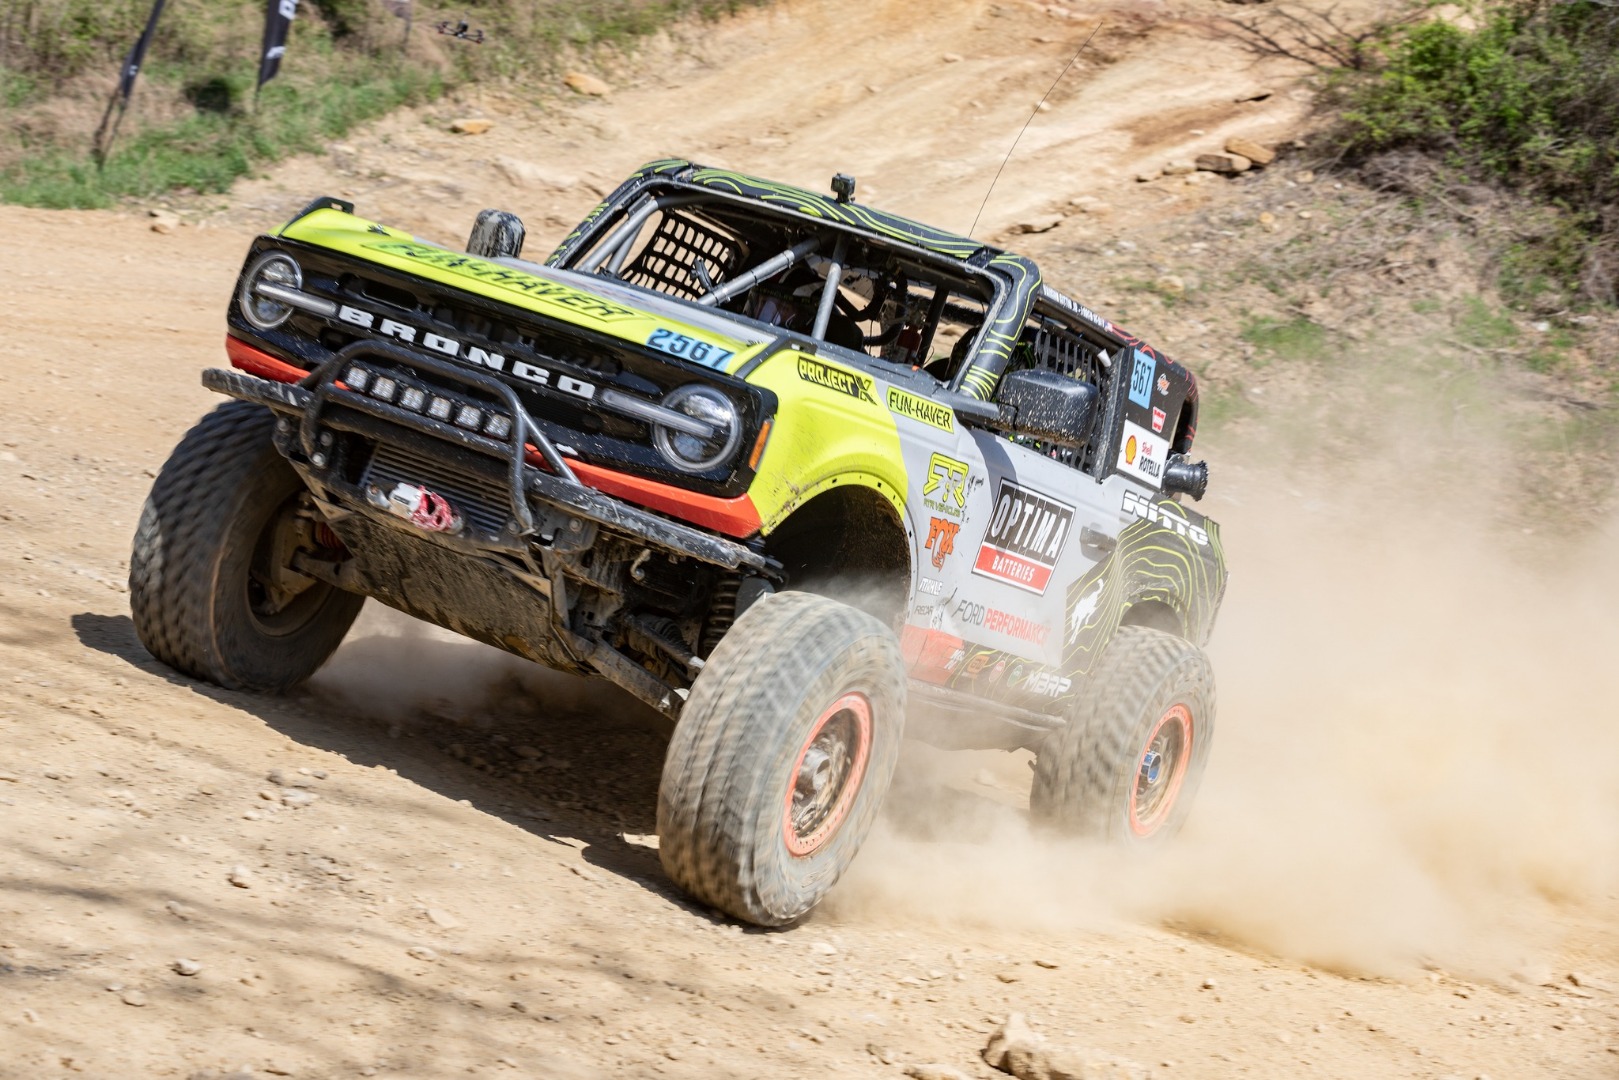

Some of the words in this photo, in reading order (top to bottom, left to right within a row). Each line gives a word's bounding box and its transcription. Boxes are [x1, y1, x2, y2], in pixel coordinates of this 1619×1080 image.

[339, 305, 596, 400] BRONCO
[648, 328, 735, 366] 2567
[800, 359, 854, 397] PROJECT
[1132, 363, 1152, 397] 567
[889, 391, 951, 429] FUN-HAVER
[991, 494, 1067, 559] OPTIMA
[992, 555, 1035, 582] BATTERIES
[951, 600, 985, 626] FORD
[1023, 671, 1071, 697] MBRP
